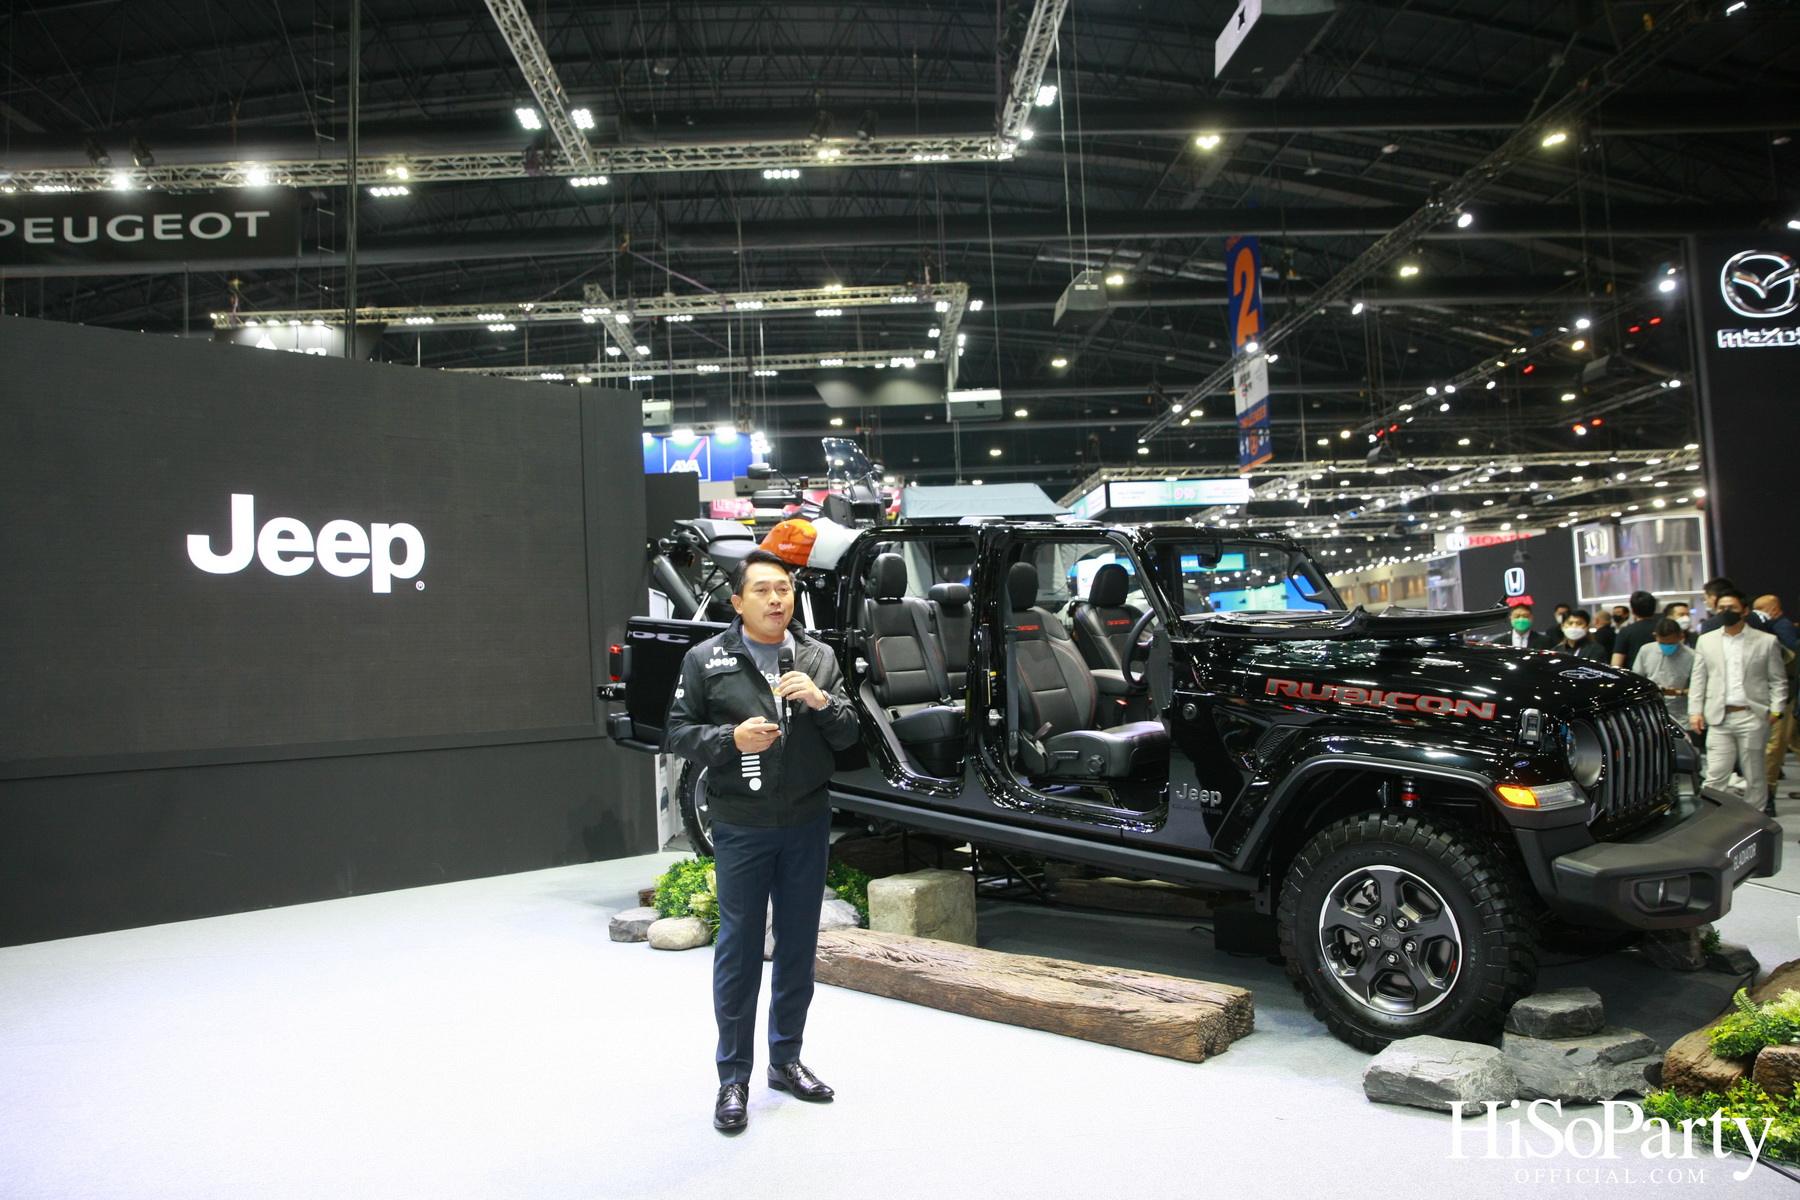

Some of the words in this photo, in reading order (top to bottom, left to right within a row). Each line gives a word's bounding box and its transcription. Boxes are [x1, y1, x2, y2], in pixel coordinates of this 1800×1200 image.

[1232, 246, 1259, 348] 2
[1717, 327, 1800, 349] mazd
[186, 493, 426, 593] Jeep
[1468, 533, 1532, 548] HON
[704, 656, 738, 670] Jeep
[1264, 677, 1497, 721] RUBICON
[1175, 782, 1222, 808] Jeep
